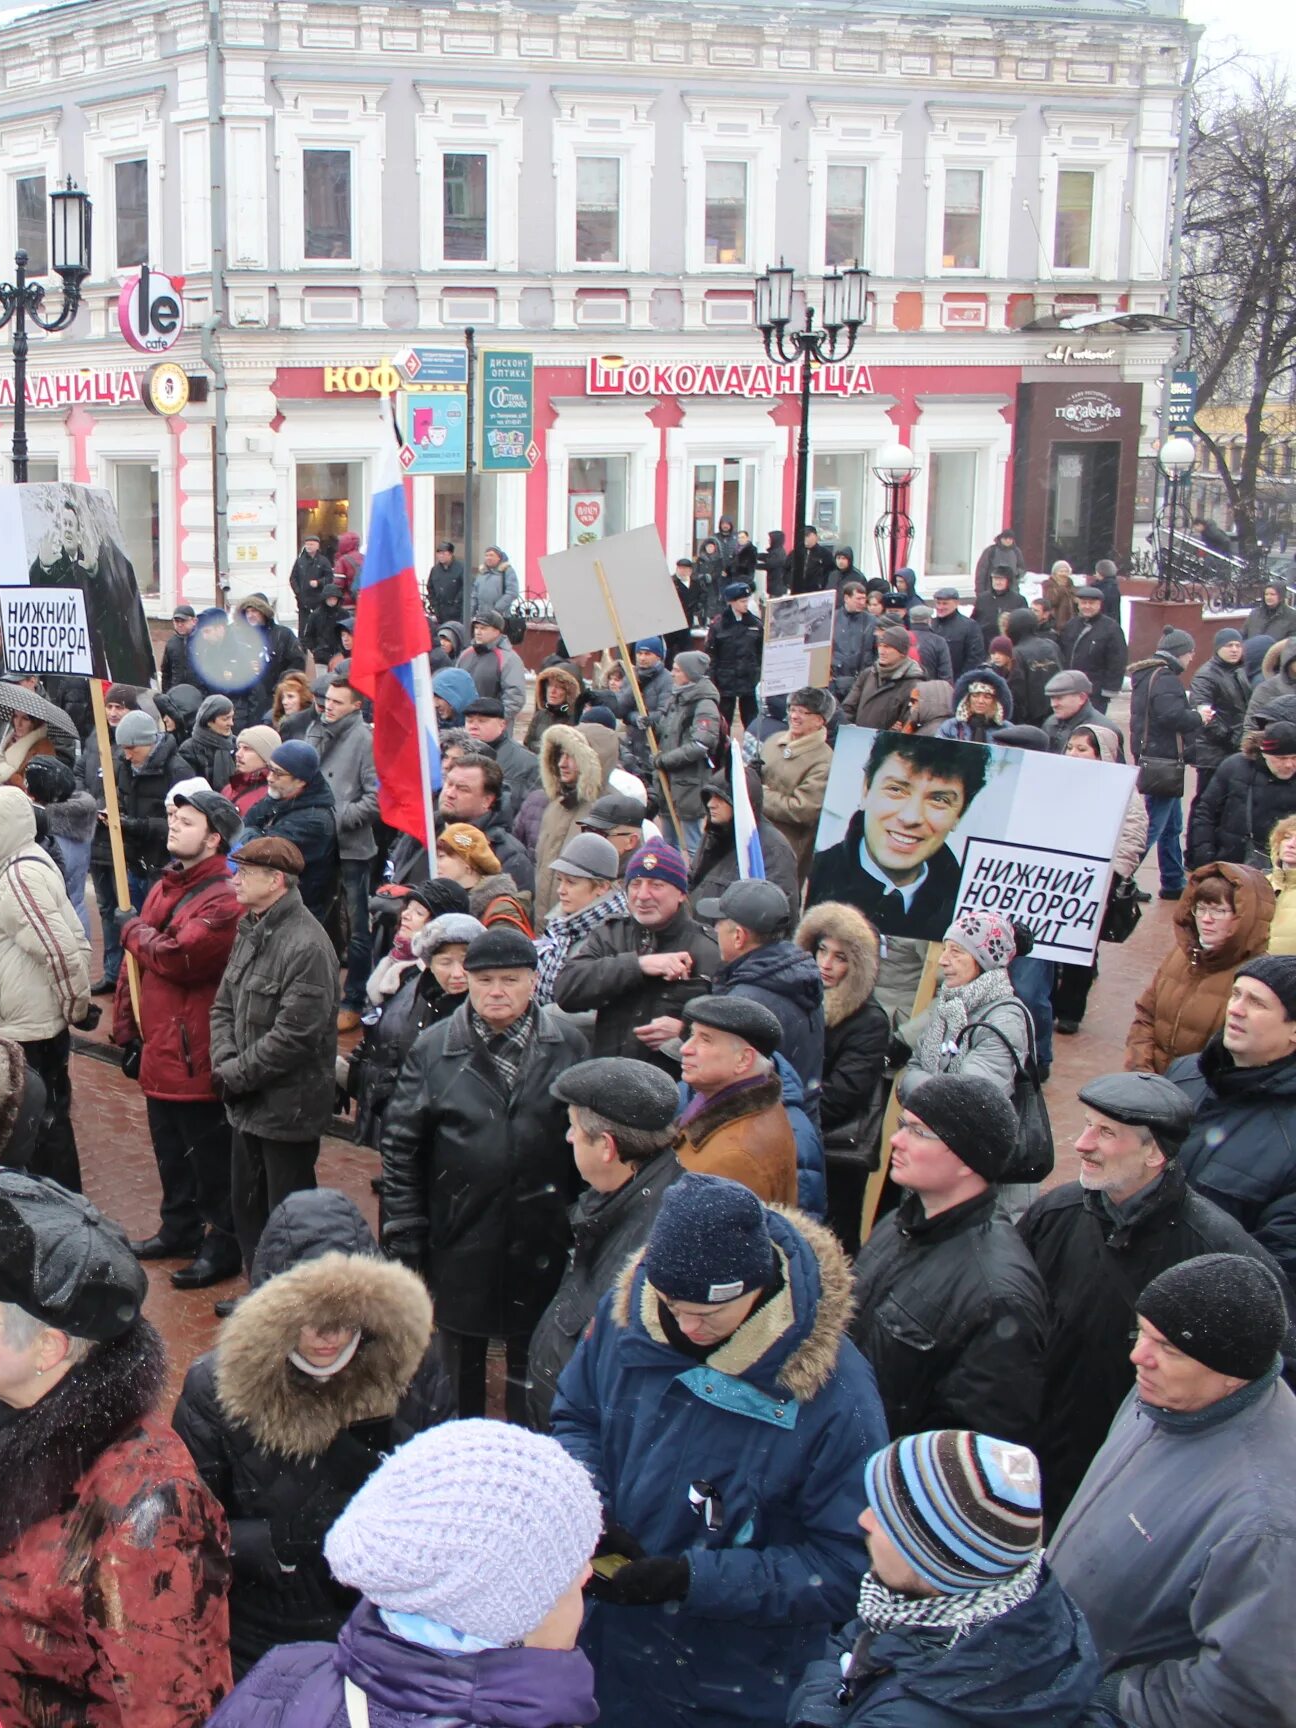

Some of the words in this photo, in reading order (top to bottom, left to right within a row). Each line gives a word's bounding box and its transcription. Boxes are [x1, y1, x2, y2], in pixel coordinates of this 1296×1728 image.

[138, 263, 180, 337] le
[145, 337, 168, 350] cafe
[489, 359, 528, 369] ДИСКОНТ
[491, 369, 526, 378] ОПТИКА
[590, 356, 873, 396] ШОКОЛАДНИЦА
[1168, 405, 1191, 414] ОНТ
[8, 596, 77, 625] НИЖНИЙ
[8, 626, 87, 656] НОВГОРОД
[8, 649, 74, 673] ПОМНИТ
[973, 857, 1095, 897] НИЖНИЙ
[962, 881, 1100, 930] НОВГОРОД
[955, 906, 1068, 944] ПИТ
